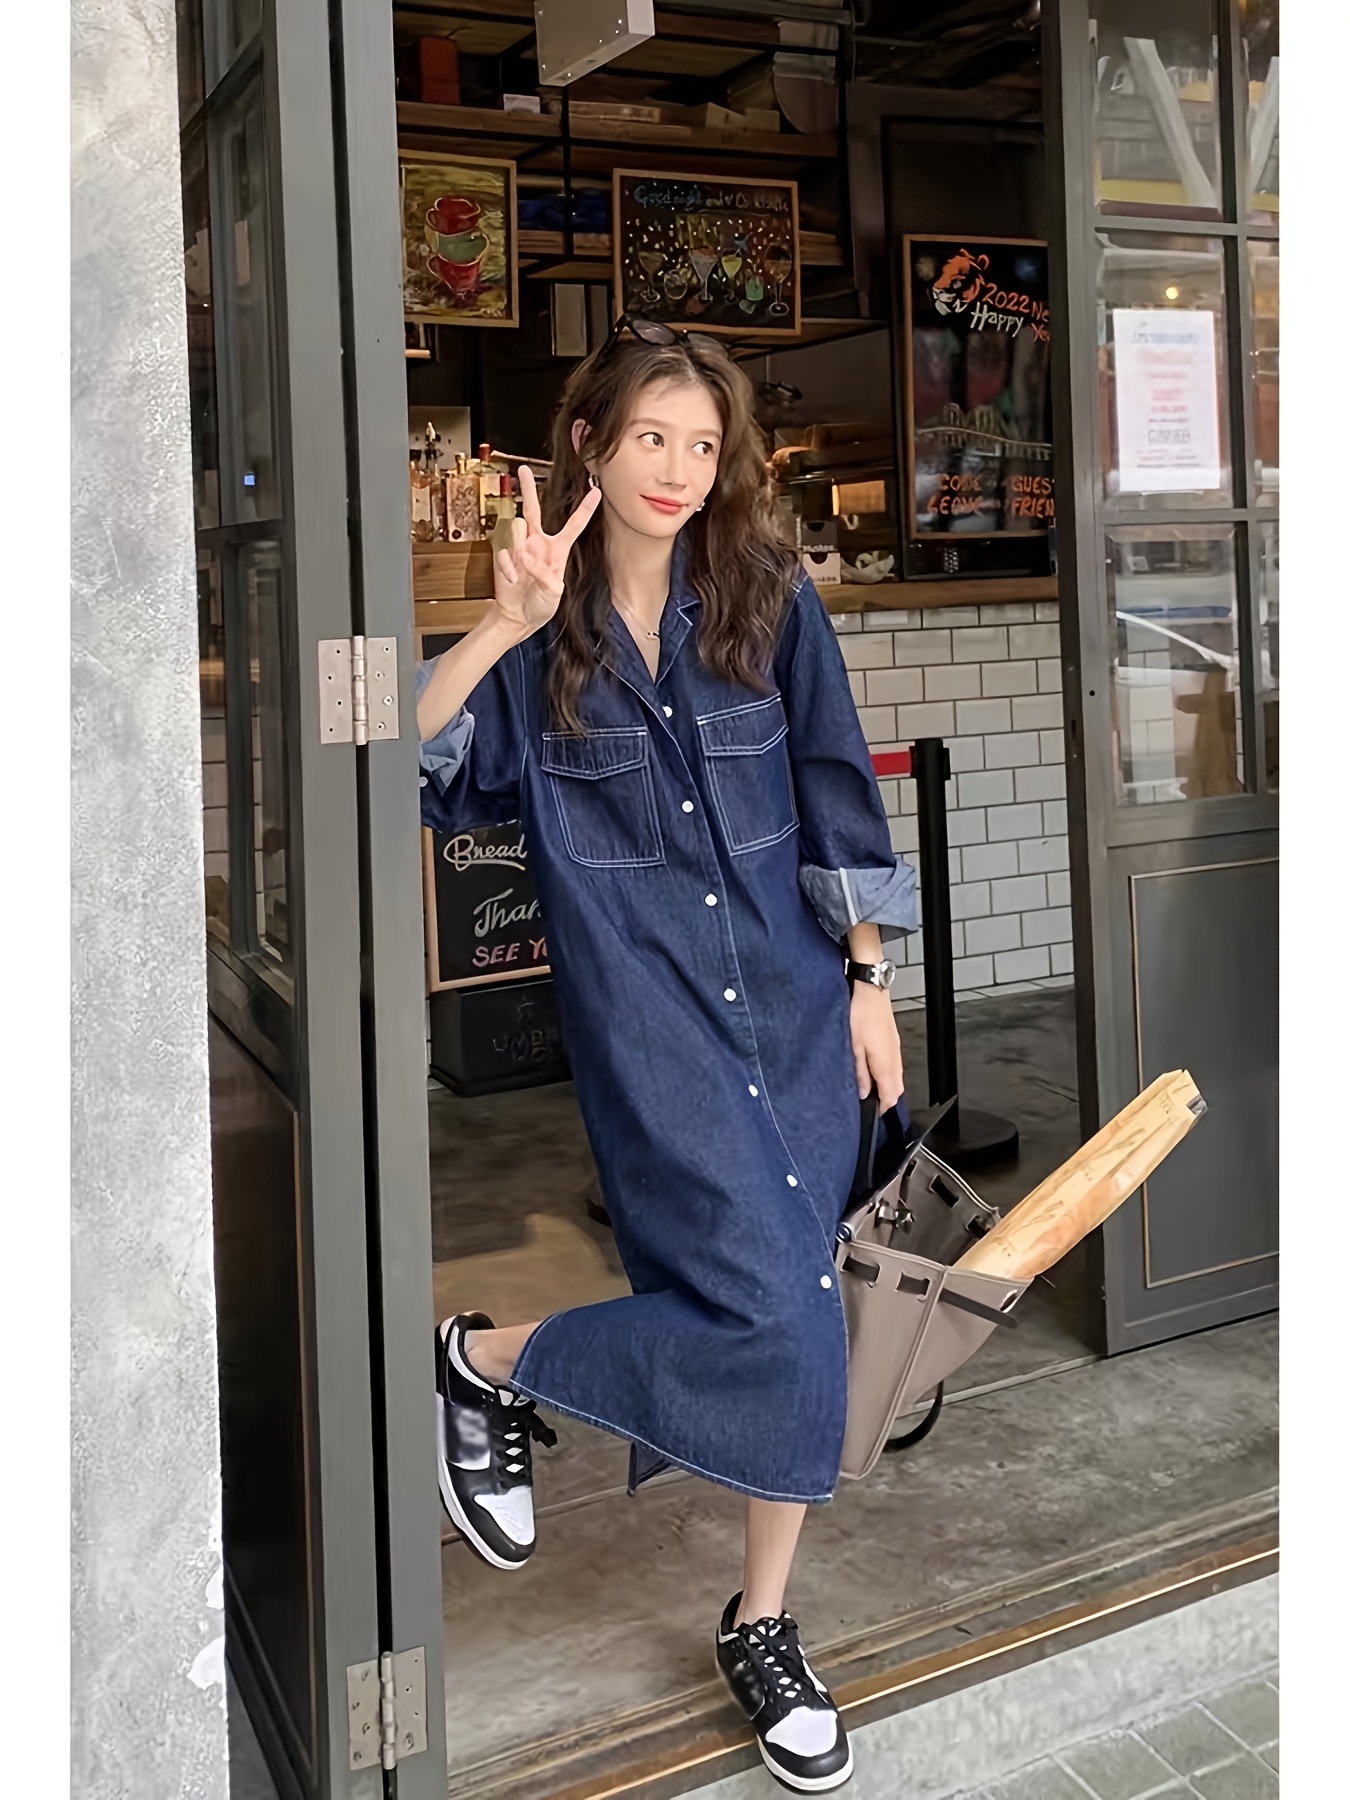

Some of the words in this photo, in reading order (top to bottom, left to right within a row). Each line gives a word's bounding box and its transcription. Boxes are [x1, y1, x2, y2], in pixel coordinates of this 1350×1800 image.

[982, 282, 1030, 314] 2022
[970, 301, 1024, 338] Happy
[443, 834, 528, 872] Bread
[472, 942, 521, 967] SEE
